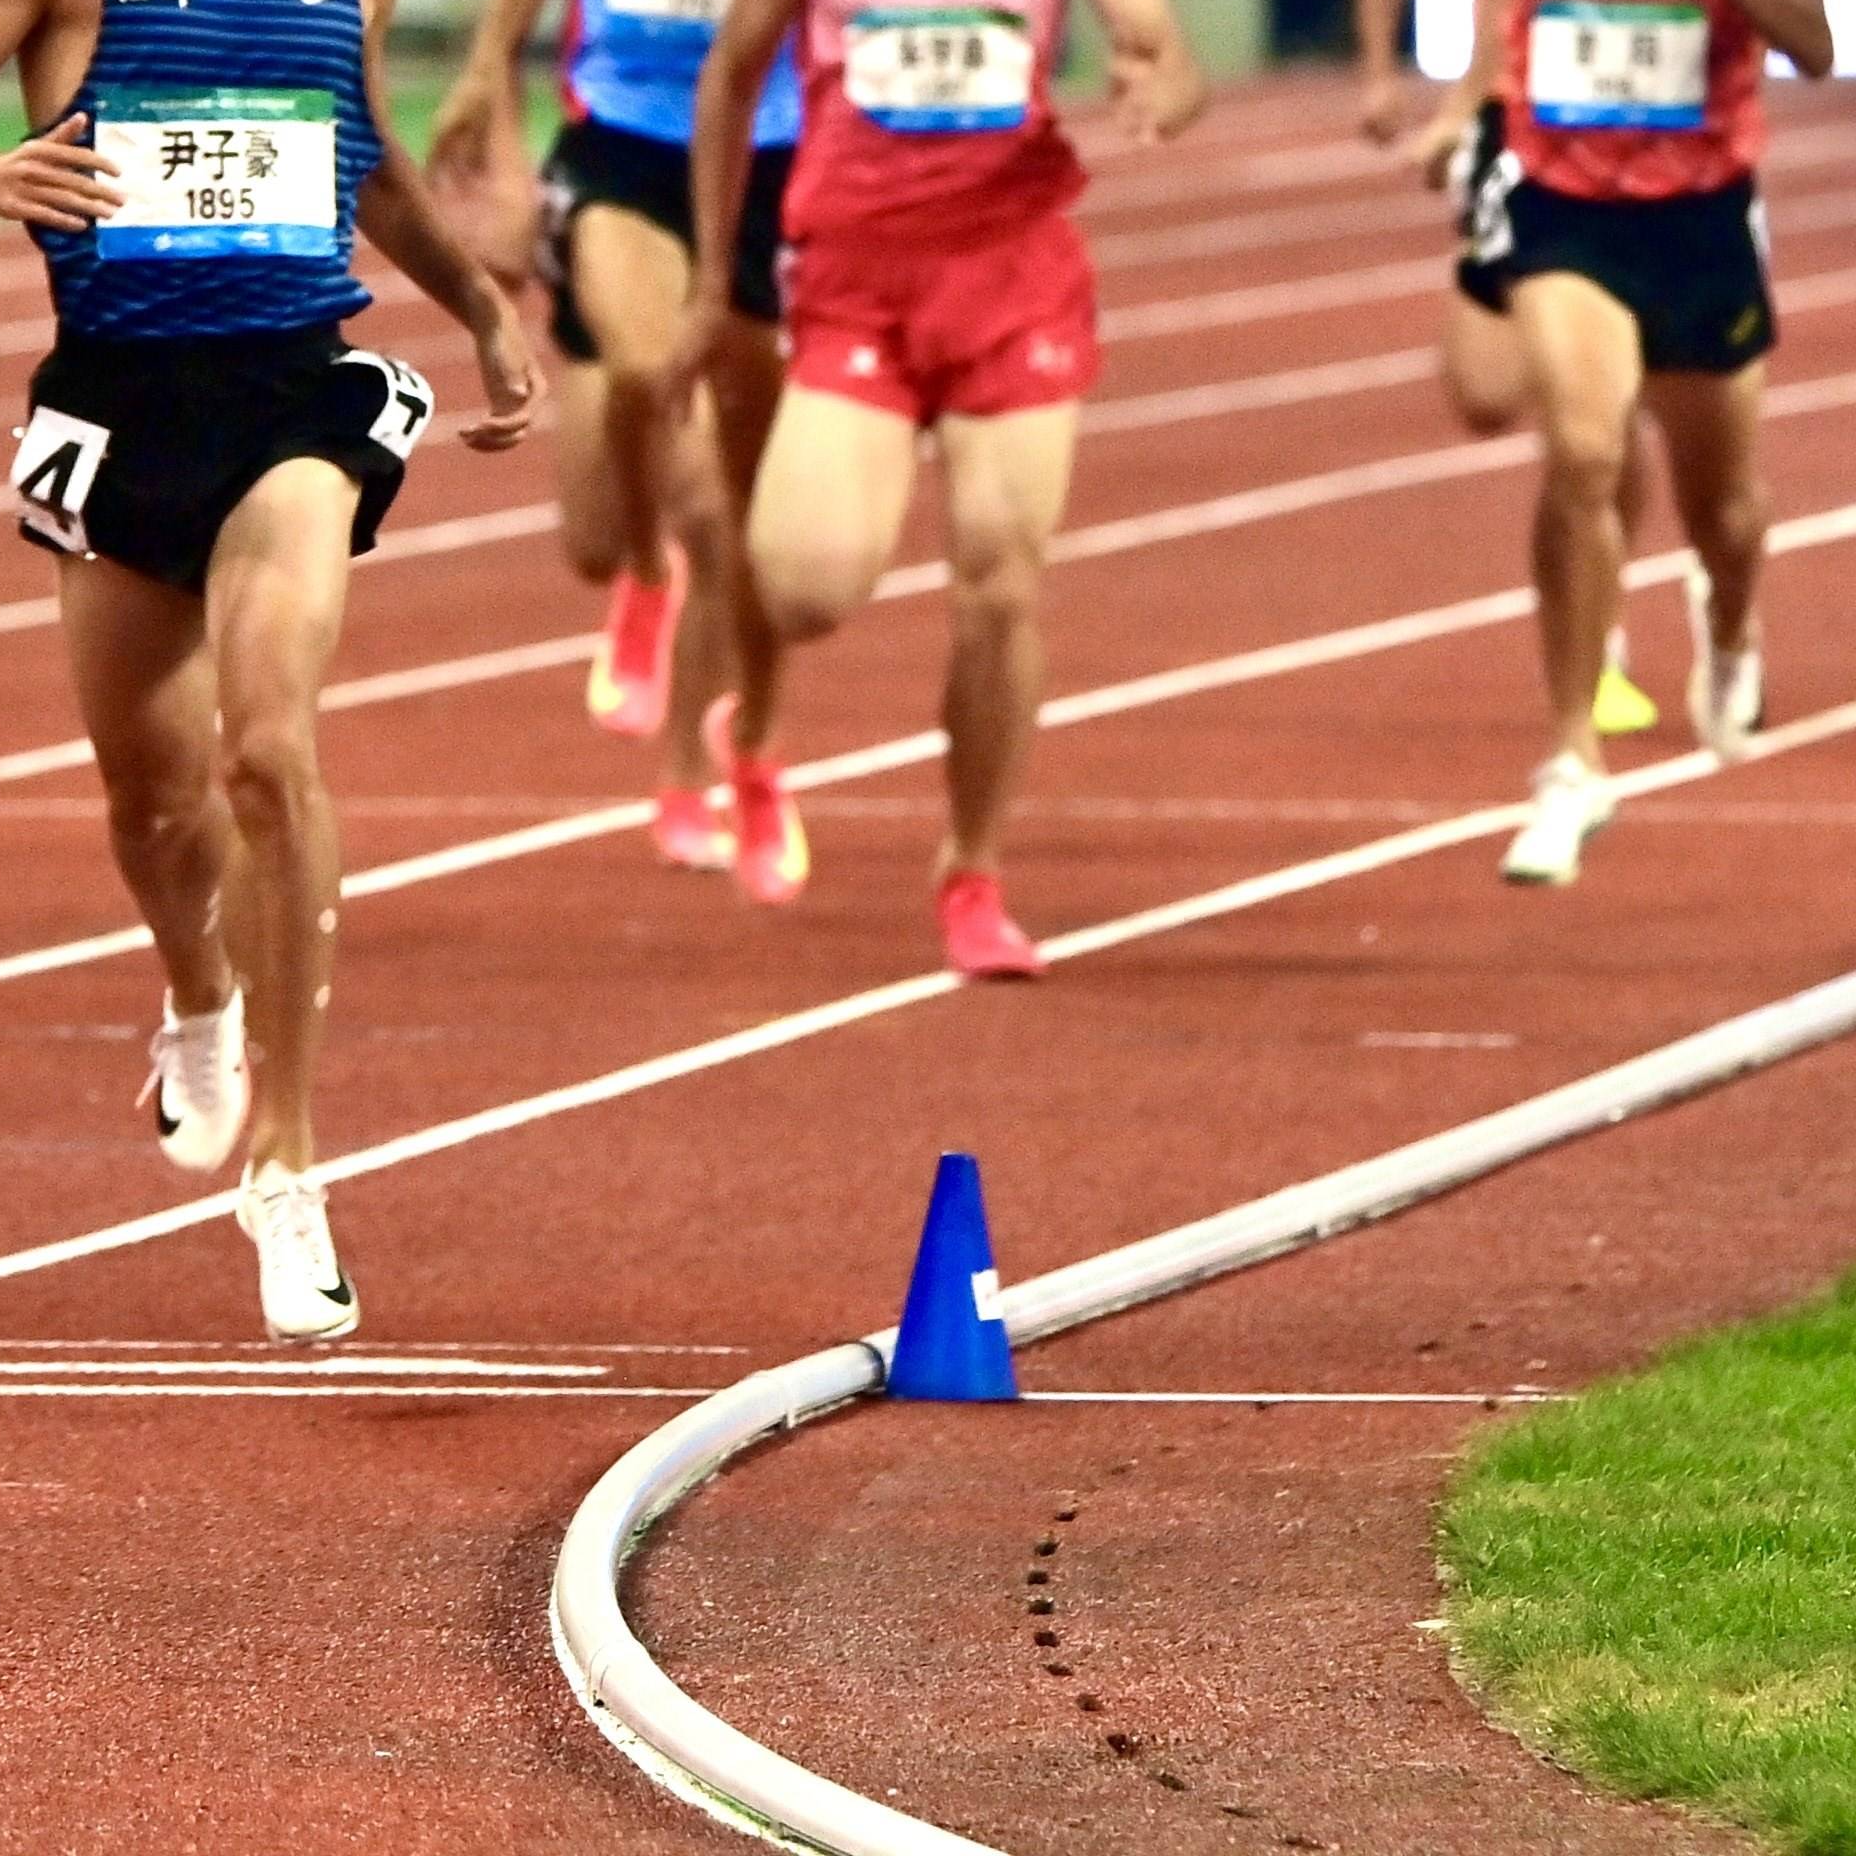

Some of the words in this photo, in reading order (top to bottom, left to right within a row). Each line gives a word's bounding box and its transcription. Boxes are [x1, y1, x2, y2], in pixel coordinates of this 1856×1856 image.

[159, 129, 279, 181] 尹子豪
[185, 187, 256, 220] 1895
[18, 441, 85, 533] 4
